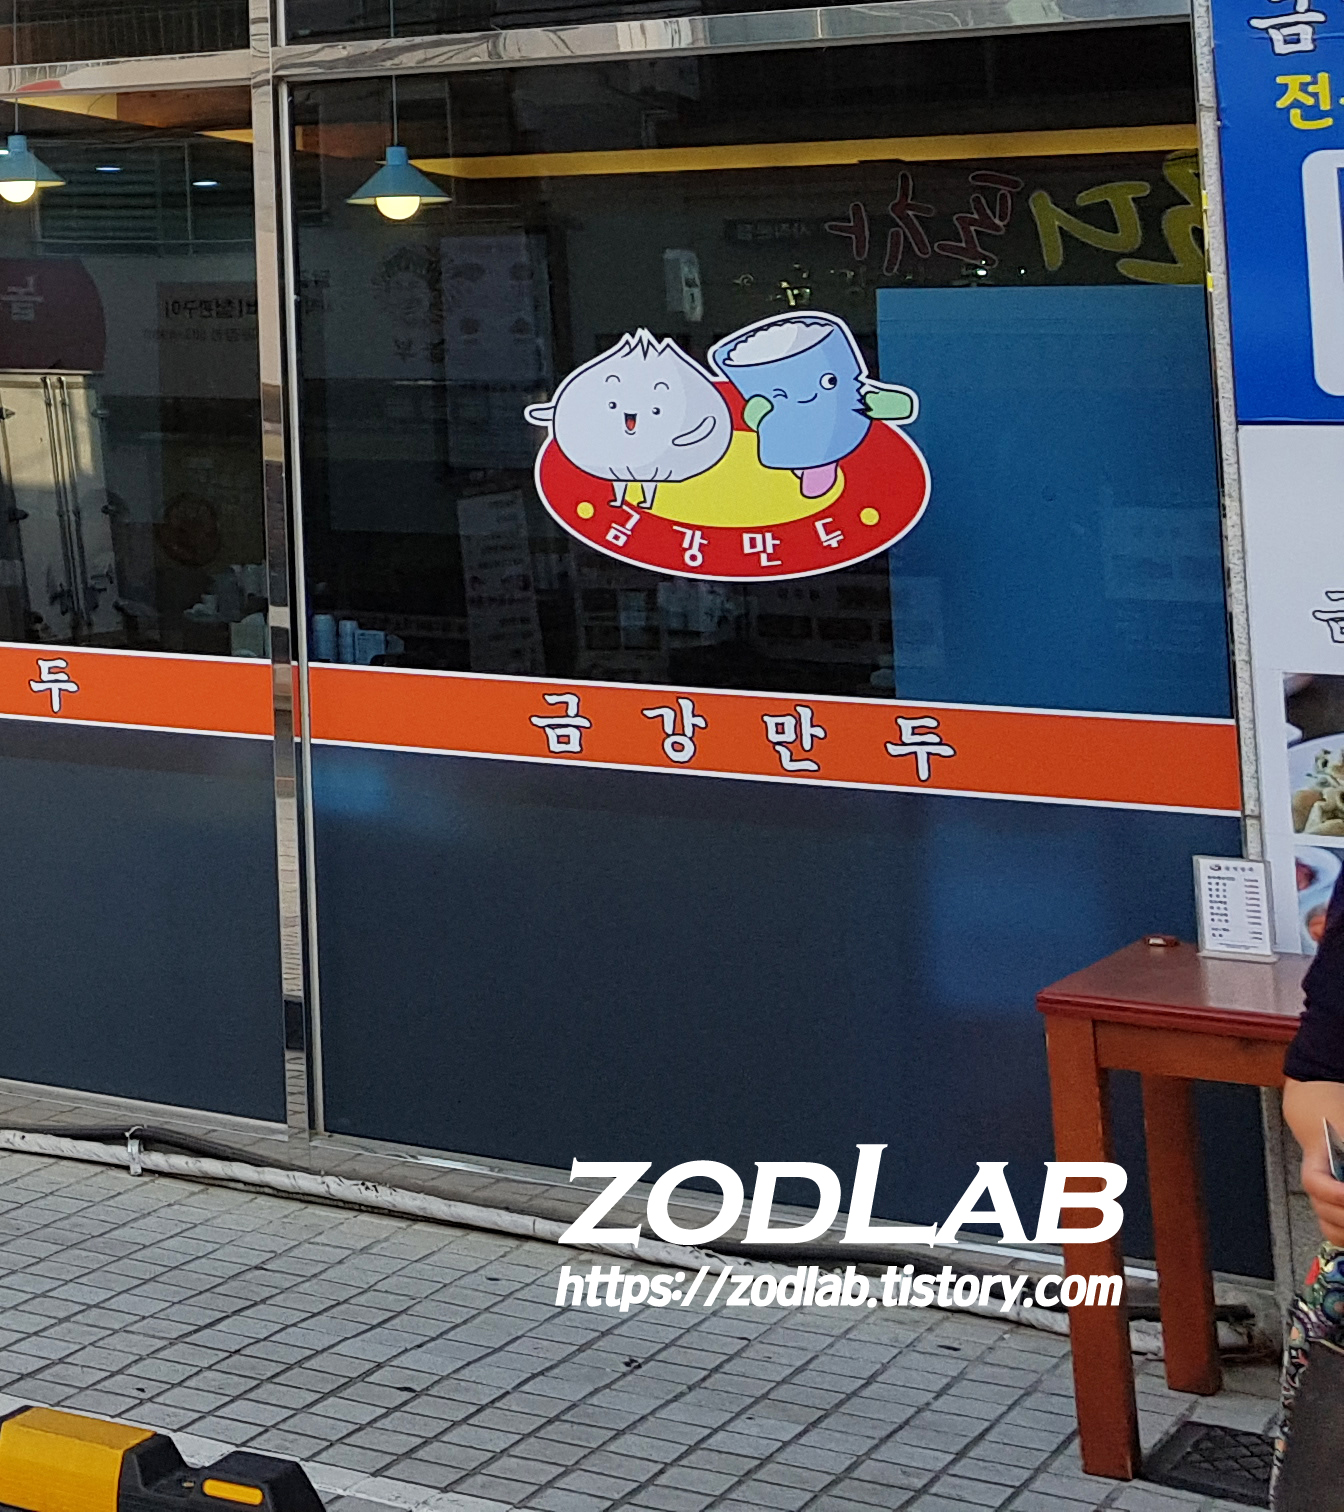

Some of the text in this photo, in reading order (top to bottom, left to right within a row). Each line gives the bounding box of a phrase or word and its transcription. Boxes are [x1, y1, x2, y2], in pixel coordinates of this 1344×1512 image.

[1276, 72, 1344, 130] 전
[606, 504, 847, 568] 금강만두
[529, 692, 956, 782] 금강만두
